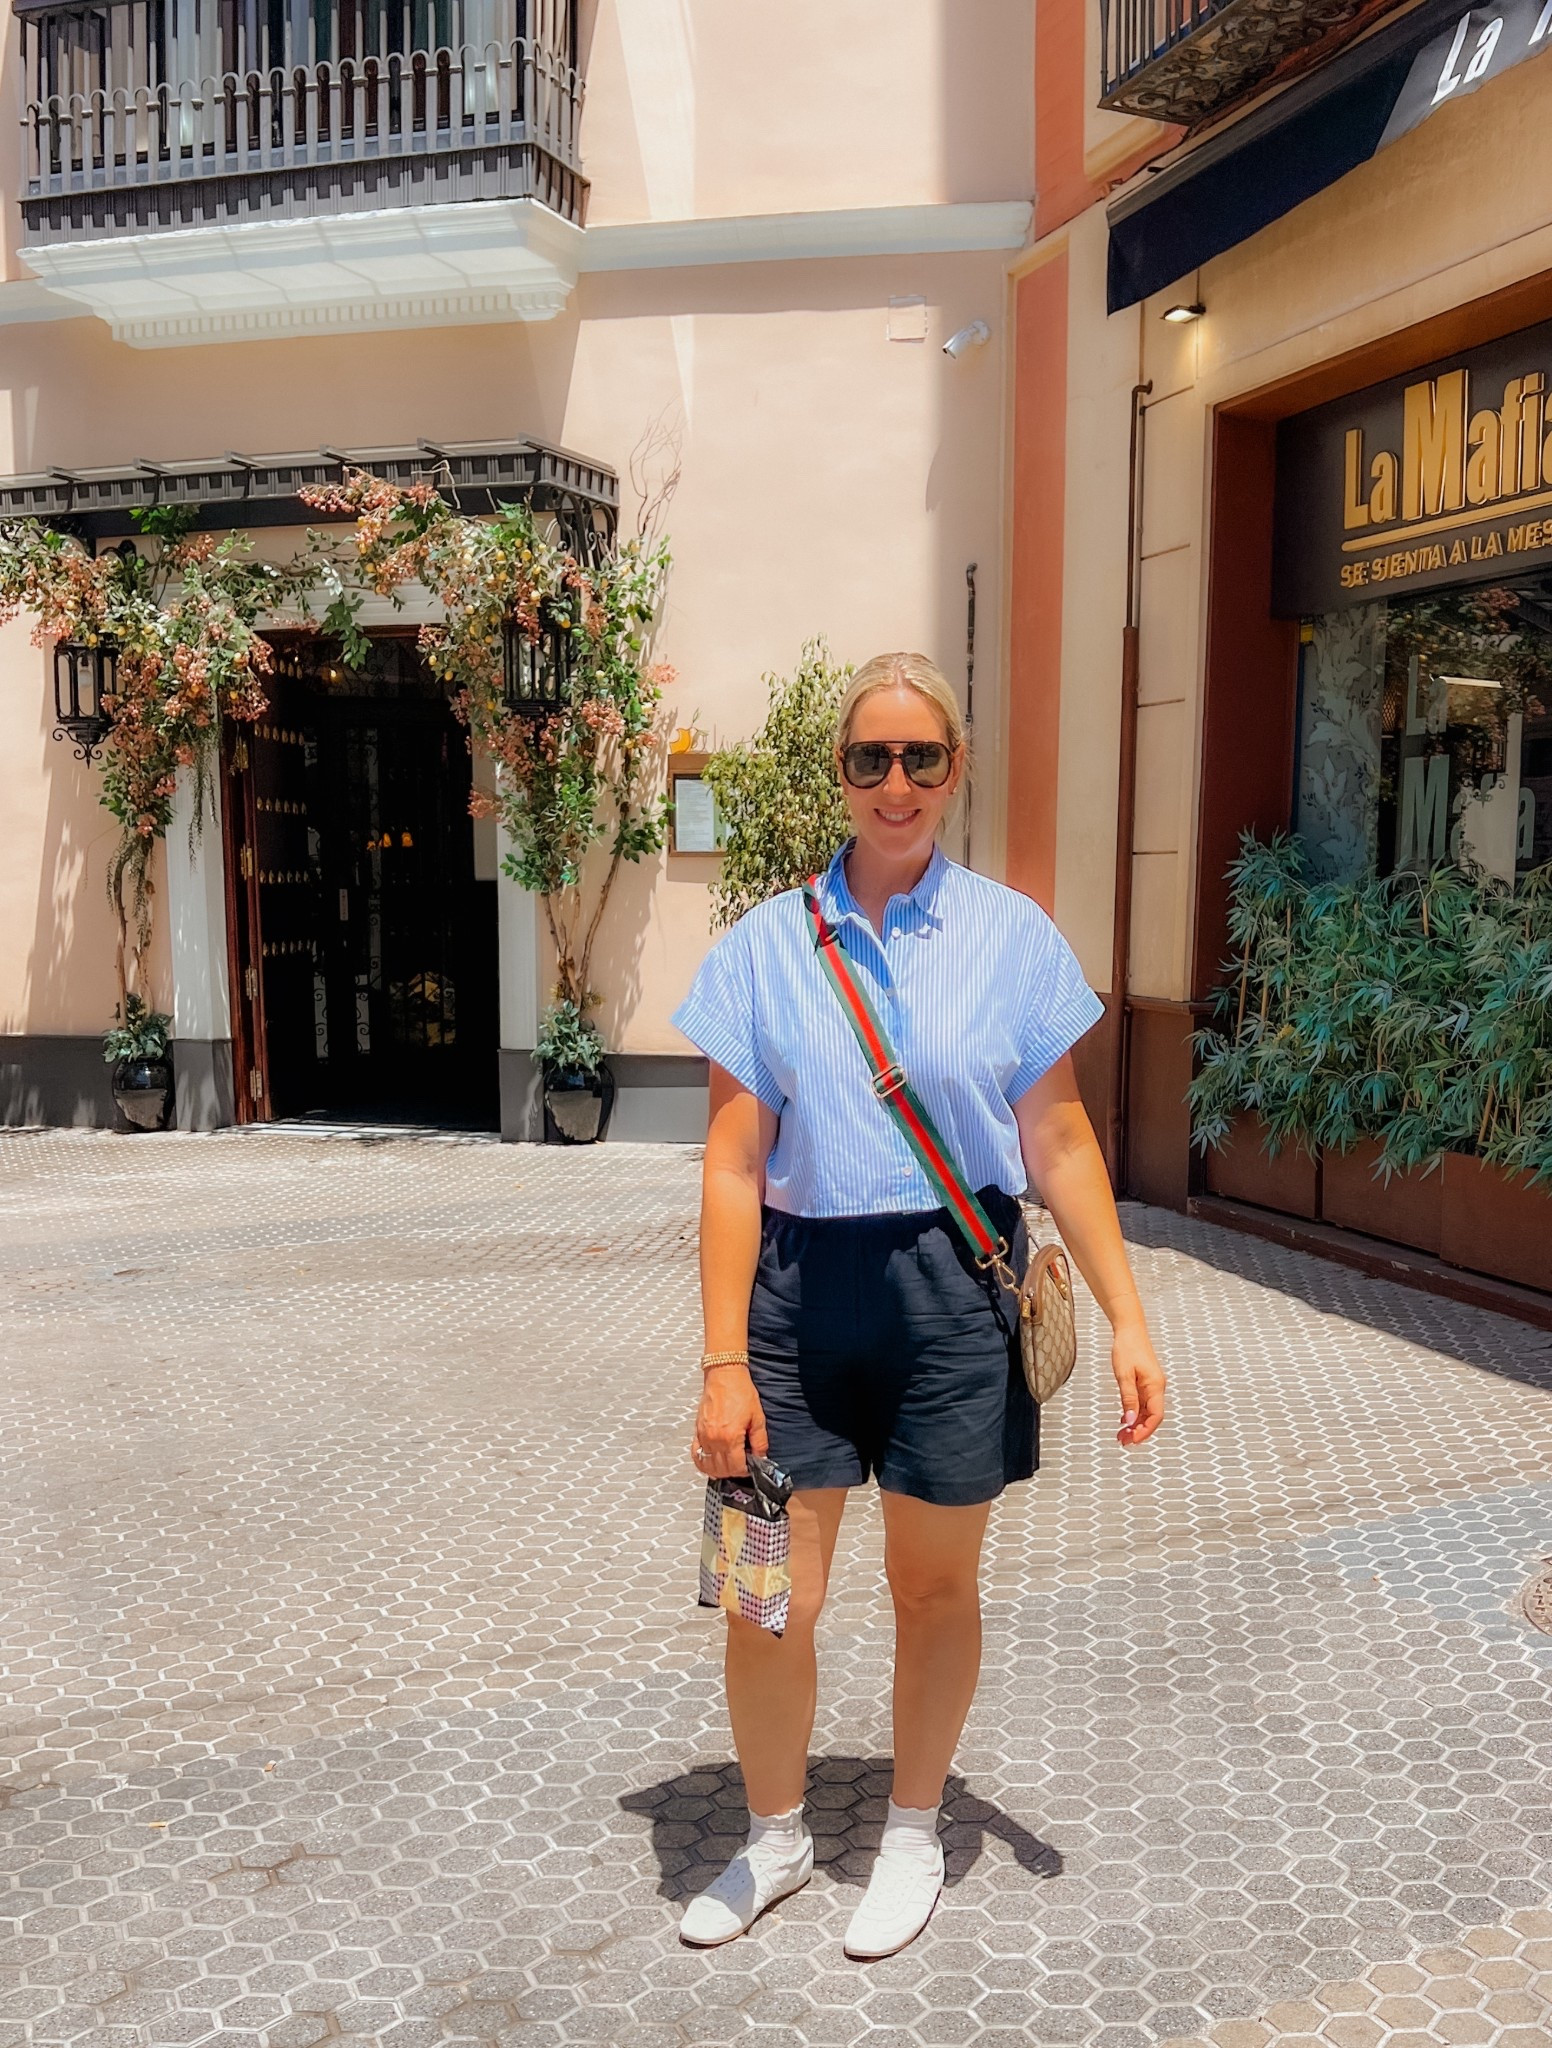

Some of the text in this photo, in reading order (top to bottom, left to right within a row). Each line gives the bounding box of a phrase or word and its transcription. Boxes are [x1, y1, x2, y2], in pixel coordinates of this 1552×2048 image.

[1430, 11, 1504, 106] La
[1344, 368, 1552, 530] La Mafi
[1340, 562, 1370, 588] SE
[1371, 544, 1447, 581] SIENTA
[1450, 539, 1468, 565] A
[1470, 531, 1503, 561] LA
[1406, 655, 1448, 736] La
